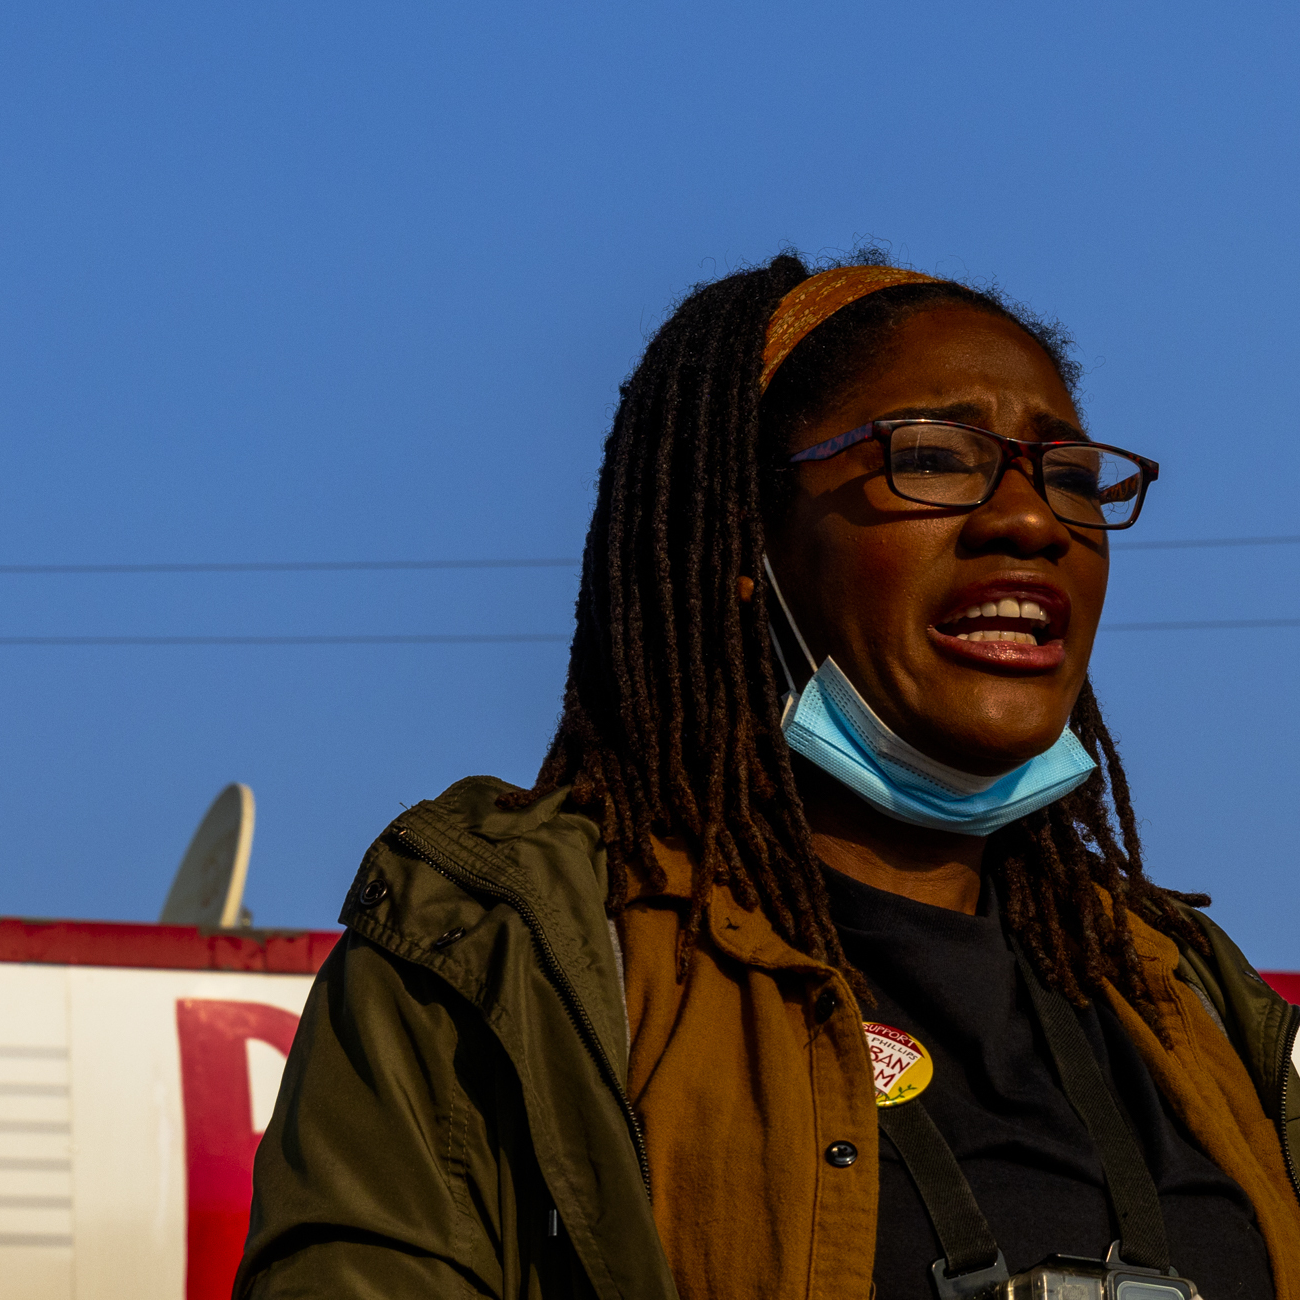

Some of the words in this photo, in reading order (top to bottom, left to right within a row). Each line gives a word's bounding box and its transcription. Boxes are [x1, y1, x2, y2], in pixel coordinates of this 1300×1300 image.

[862, 1023, 915, 1048] SUPPORT
[869, 1045, 911, 1074] BAN
[871, 1036, 919, 1061] PHILLIPS
